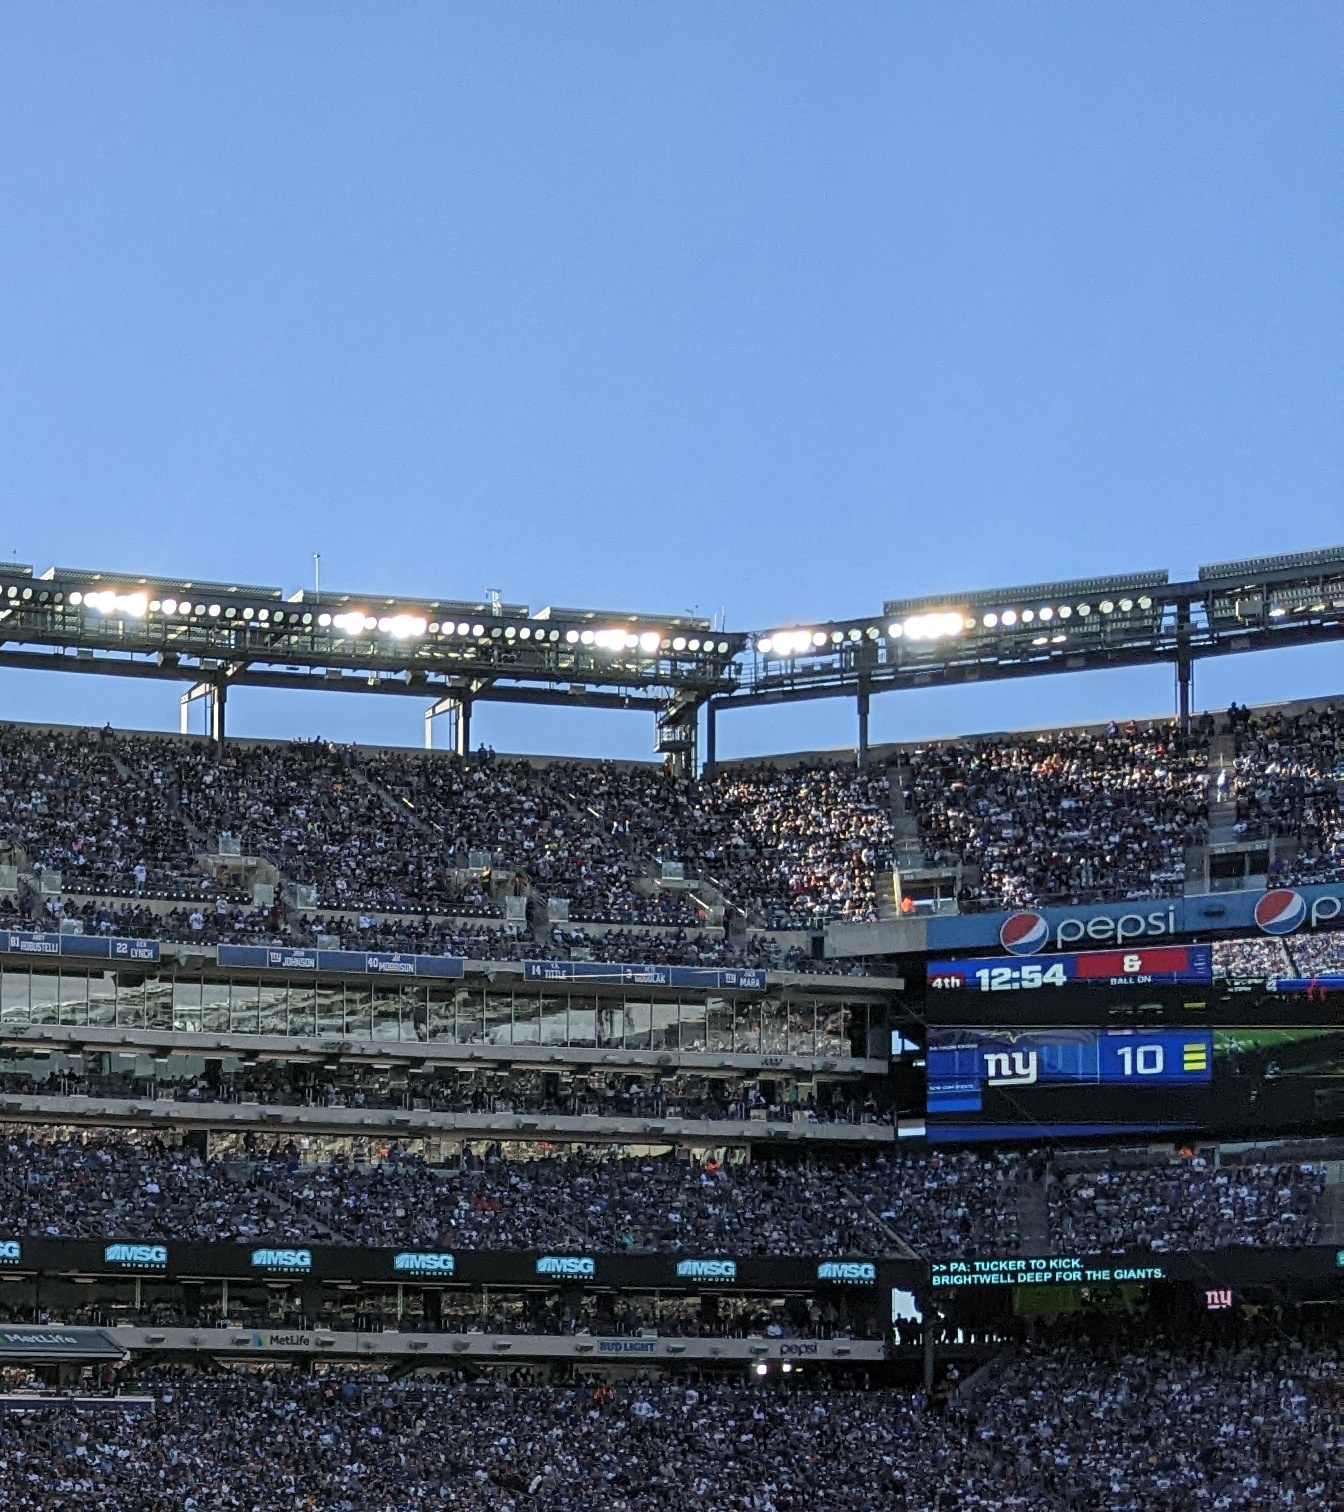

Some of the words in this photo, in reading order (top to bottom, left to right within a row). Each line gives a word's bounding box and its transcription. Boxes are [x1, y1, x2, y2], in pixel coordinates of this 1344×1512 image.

[1056, 906, 1175, 949] pepsi
[932, 976, 960, 990] 4th
[976, 963, 1067, 992] 12:54
[1110, 976, 1135, 986] BALL
[984, 1050, 1037, 1086] ny
[1117, 1044, 1163, 1076] 10
[120, 1246, 167, 1263] MSG
[409, 1253, 454, 1271] MSG
[831, 1263, 876, 1279] MSG
[949, 1262, 971, 1273] PA:
[973, 1260, 1026, 1272] TUCKER
[1029, 1259, 1047, 1271] TO
[1049, 1258, 1084, 1270] KICK.
[932, 1273, 1015, 1287] BRIGHTWELL
[1017, 1272, 1053, 1283] DEEP
[1055, 1271, 1082, 1282] FOR
[1085, 1270, 1111, 1281] THE
[1114, 1268, 1166, 1280] GIANTS.
[4, 1331, 78, 1345] MetLife
[269, 1334, 310, 1348] MetLife
[598, 1341, 623, 1353] BUD
[624, 1341, 656, 1353] LIGHT
[779, 1342, 817, 1357] pepsi
